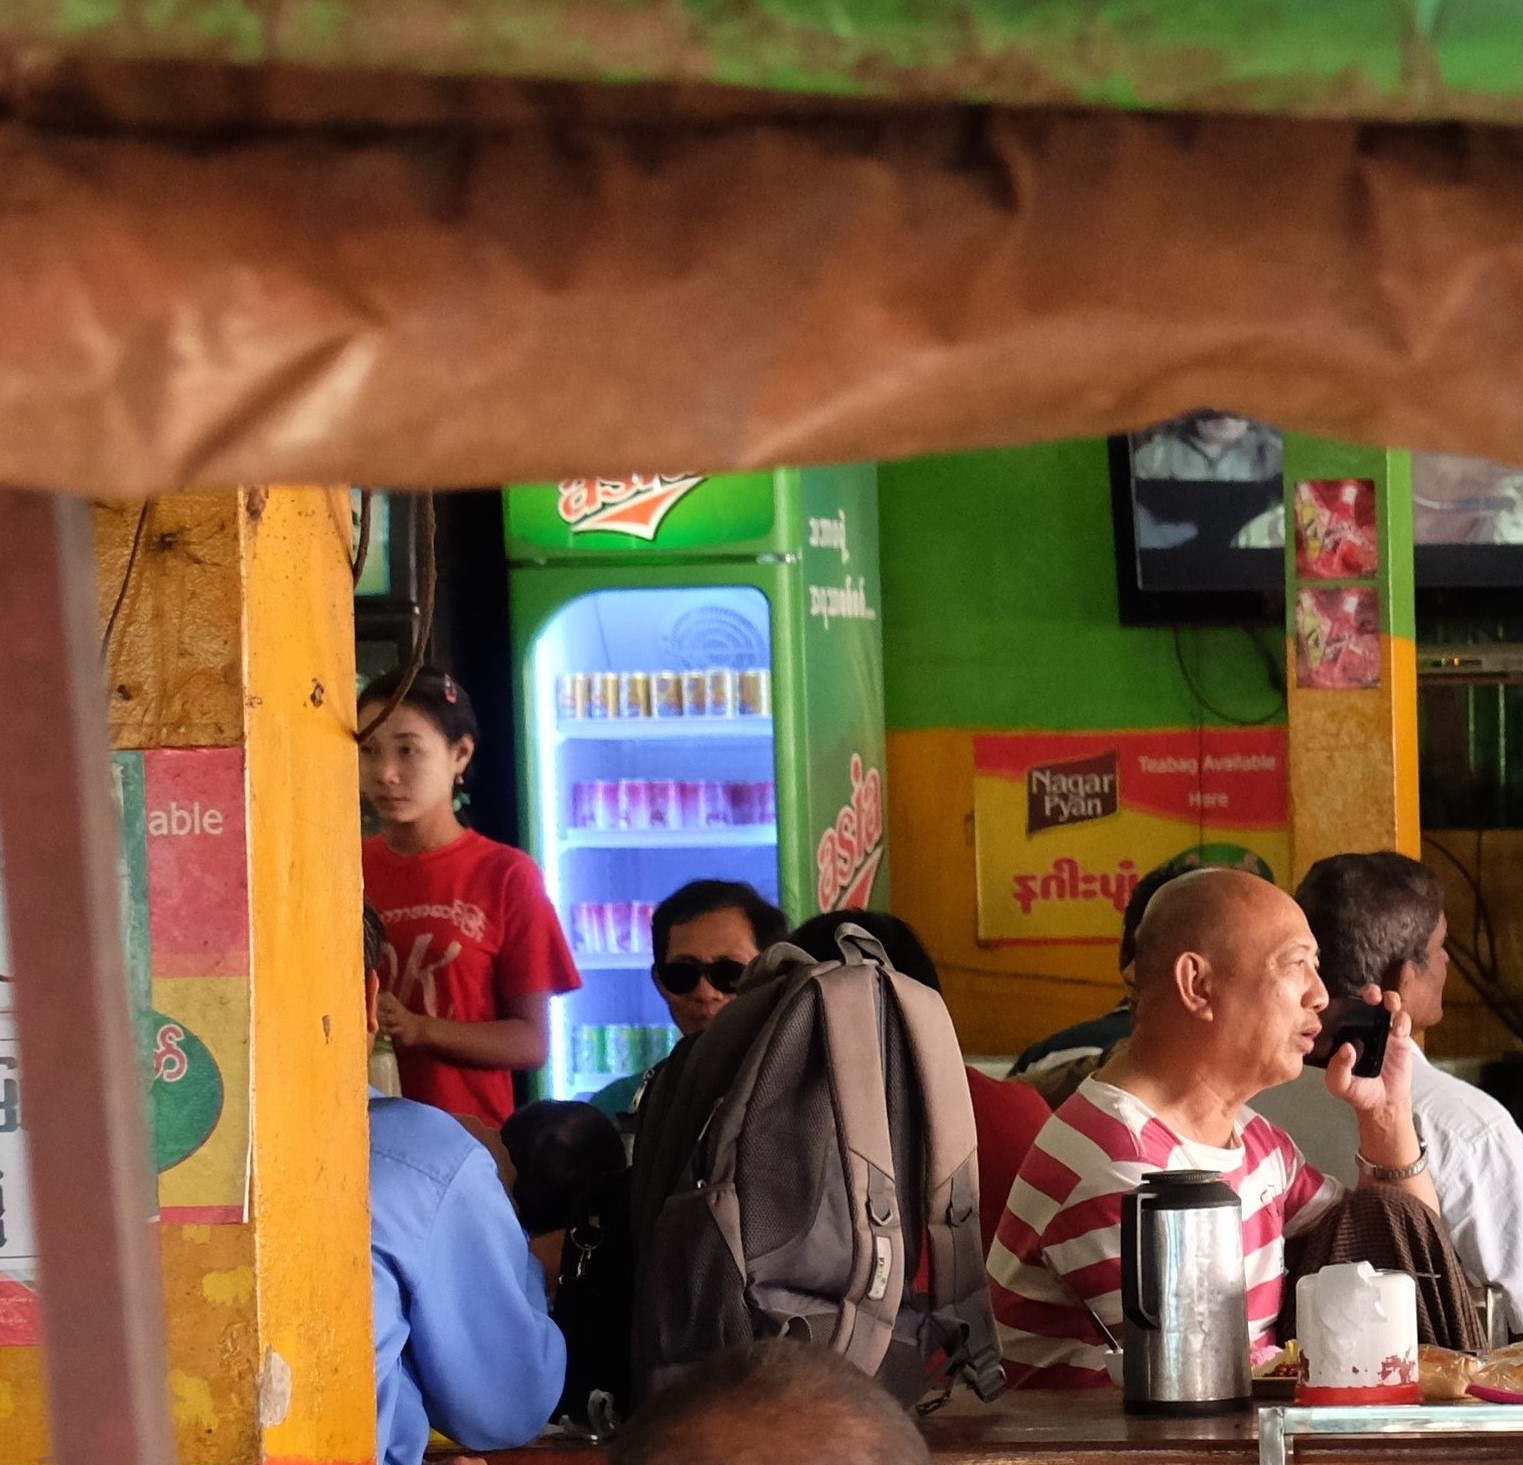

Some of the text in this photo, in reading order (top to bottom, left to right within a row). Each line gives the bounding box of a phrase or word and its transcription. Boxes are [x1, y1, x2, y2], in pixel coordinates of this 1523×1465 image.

[1136, 753, 1277, 776] Teabag Available
[1031, 768, 1115, 796] Nagar
[1043, 794, 1102, 823] Pyan
